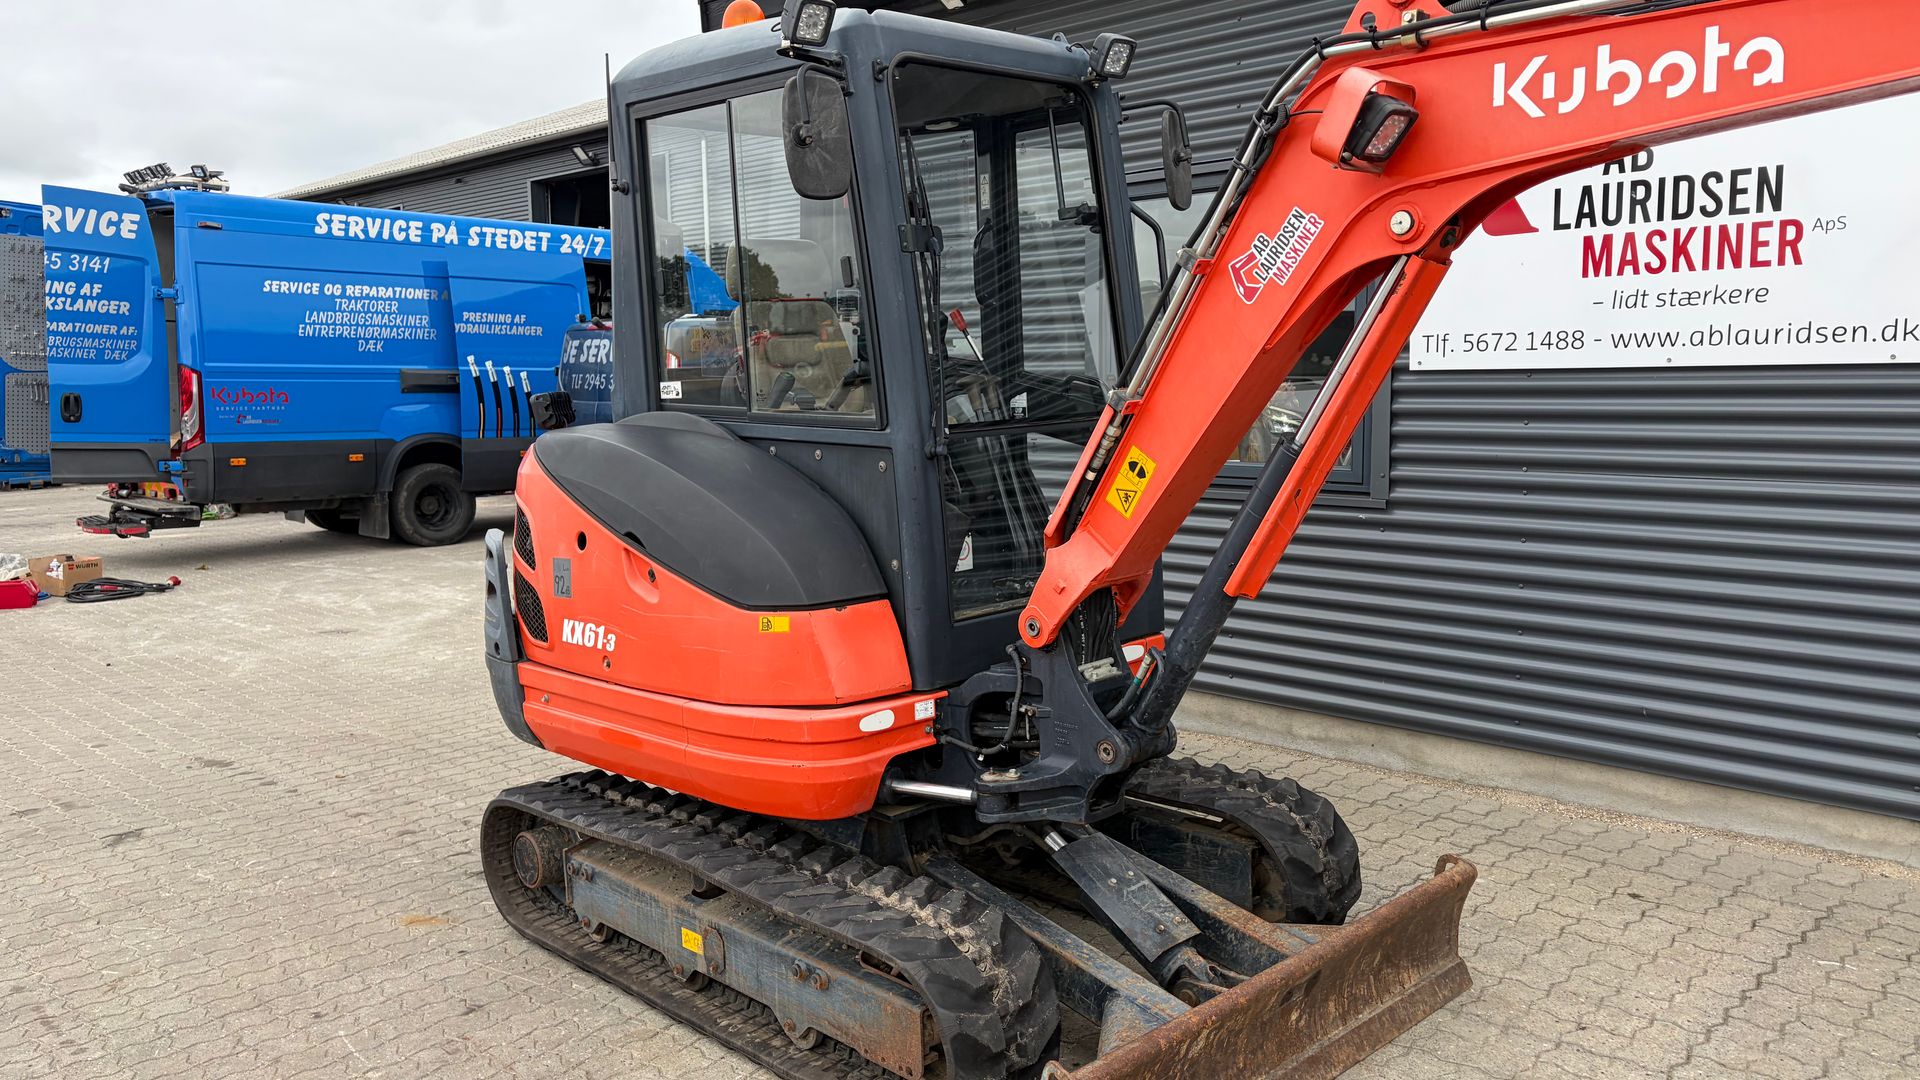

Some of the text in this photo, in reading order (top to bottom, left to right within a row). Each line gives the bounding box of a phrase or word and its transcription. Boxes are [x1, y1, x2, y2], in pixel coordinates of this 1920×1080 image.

[1492, 25, 1785, 118] Kubota
[1552, 164, 1785, 231] LAURIDSEN
[42, 204, 141, 240] RVICE
[314, 212, 606, 258] SERVICE PÅ STEDET 24/7
[1252, 234, 1272, 258] AB
[1254, 208, 1307, 282] LAURIDSEN
[1581, 215, 1848, 279] MASKINER ApS
[1272, 215, 1323, 284] MASKINER
[68, 253, 111, 274] 3141
[80, 282, 103, 297] AF
[262, 279, 320, 295] SERVICE
[323, 283, 342, 296] OG
[346, 285, 438, 301] REPARATIONER
[1611, 288, 1650, 310] lidt
[1655, 283, 1770, 308] stærkere
[334, 298, 399, 314] TRAKTORER
[462, 311, 527, 324] PRESNING AF
[305, 310, 430, 328] LANDBRUGSMASKINER
[48, 335, 138, 351] BRUGSMASKINER
[298, 324, 438, 341] ENTREPRENØRMASKINER
[1421, 332, 1455, 358] Tlf.
[1462, 331, 1518, 353] 5672
[1525, 329, 1586, 351] 1488
[1610, 317, 1920, 349] www.ablauridsen.dk
[357, 340, 384, 353] DÆK
[211, 386, 289, 405] Kubota
[562, 618, 616, 652] KX61-3
